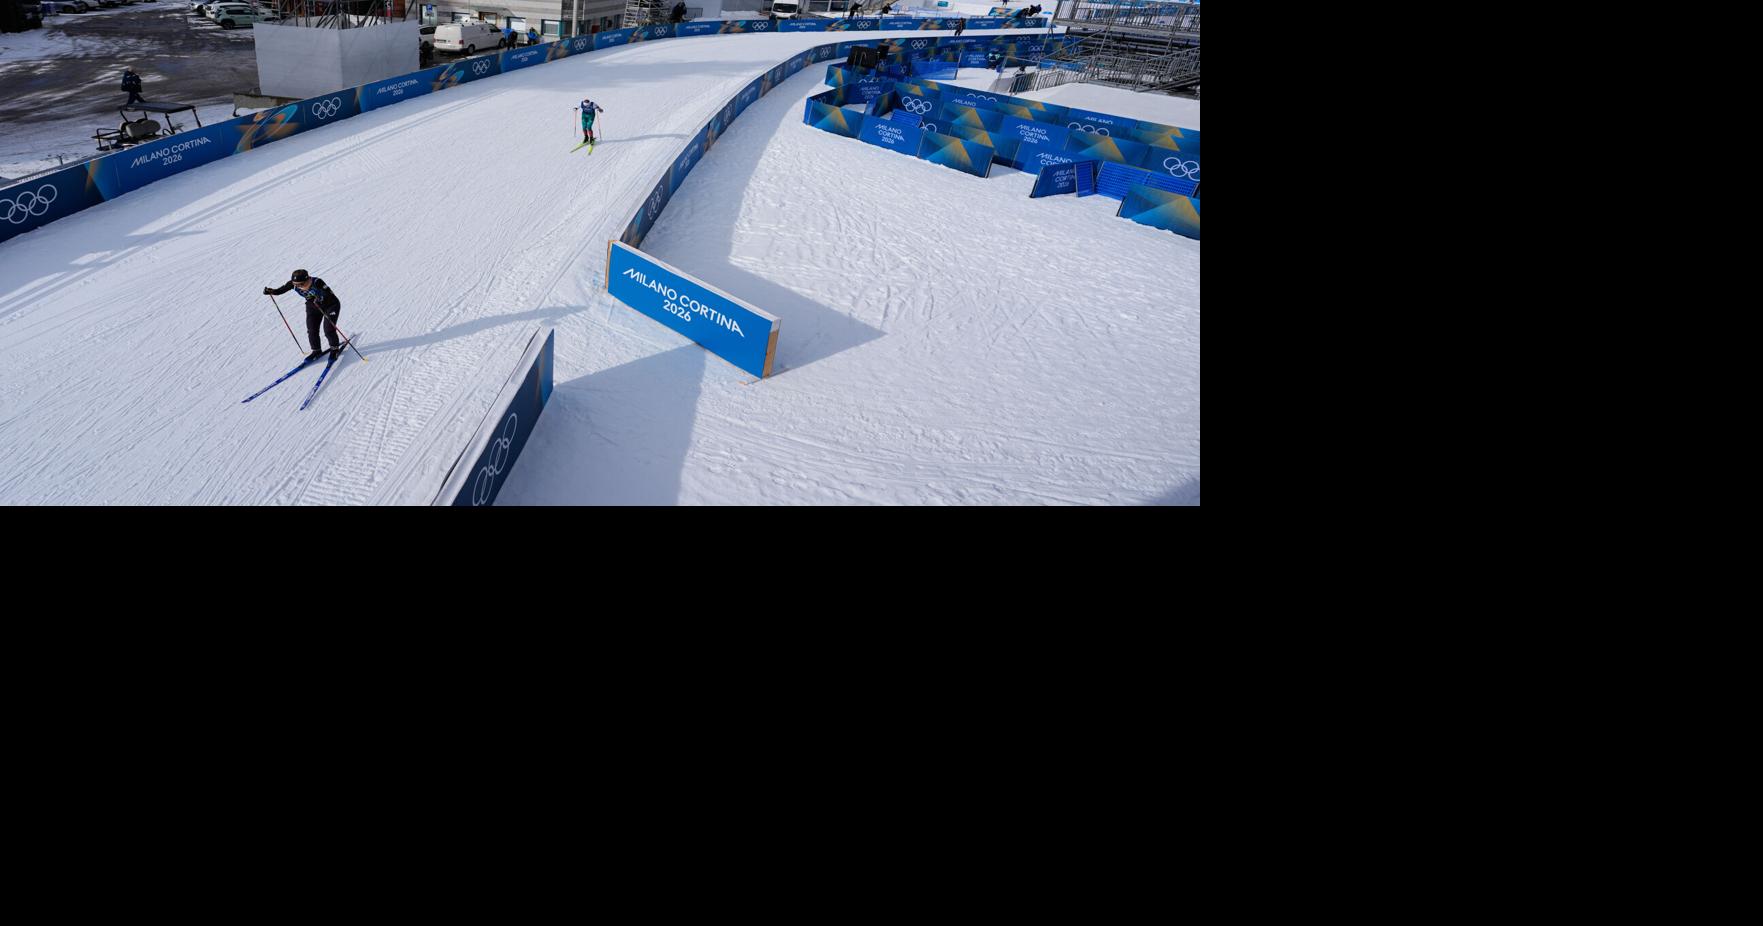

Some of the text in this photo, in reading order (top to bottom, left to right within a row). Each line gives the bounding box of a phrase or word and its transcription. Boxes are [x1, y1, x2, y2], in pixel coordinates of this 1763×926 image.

[951, 98, 976, 106] MILANO
[875, 124, 901, 134] MILANO
[878, 129, 904, 141] CORTINA
[1016, 124, 1047, 135] MILANO
[1019, 129, 1050, 141] CORTINA
[881, 136, 894, 144] 2026
[1023, 136, 1038, 144] 2026
[130, 136, 212, 168] MILANO CORTINA
[162, 153, 183, 166] 2026
[623, 268, 745, 338] MILANO CORTINA
[663, 299, 692, 322] 2026
